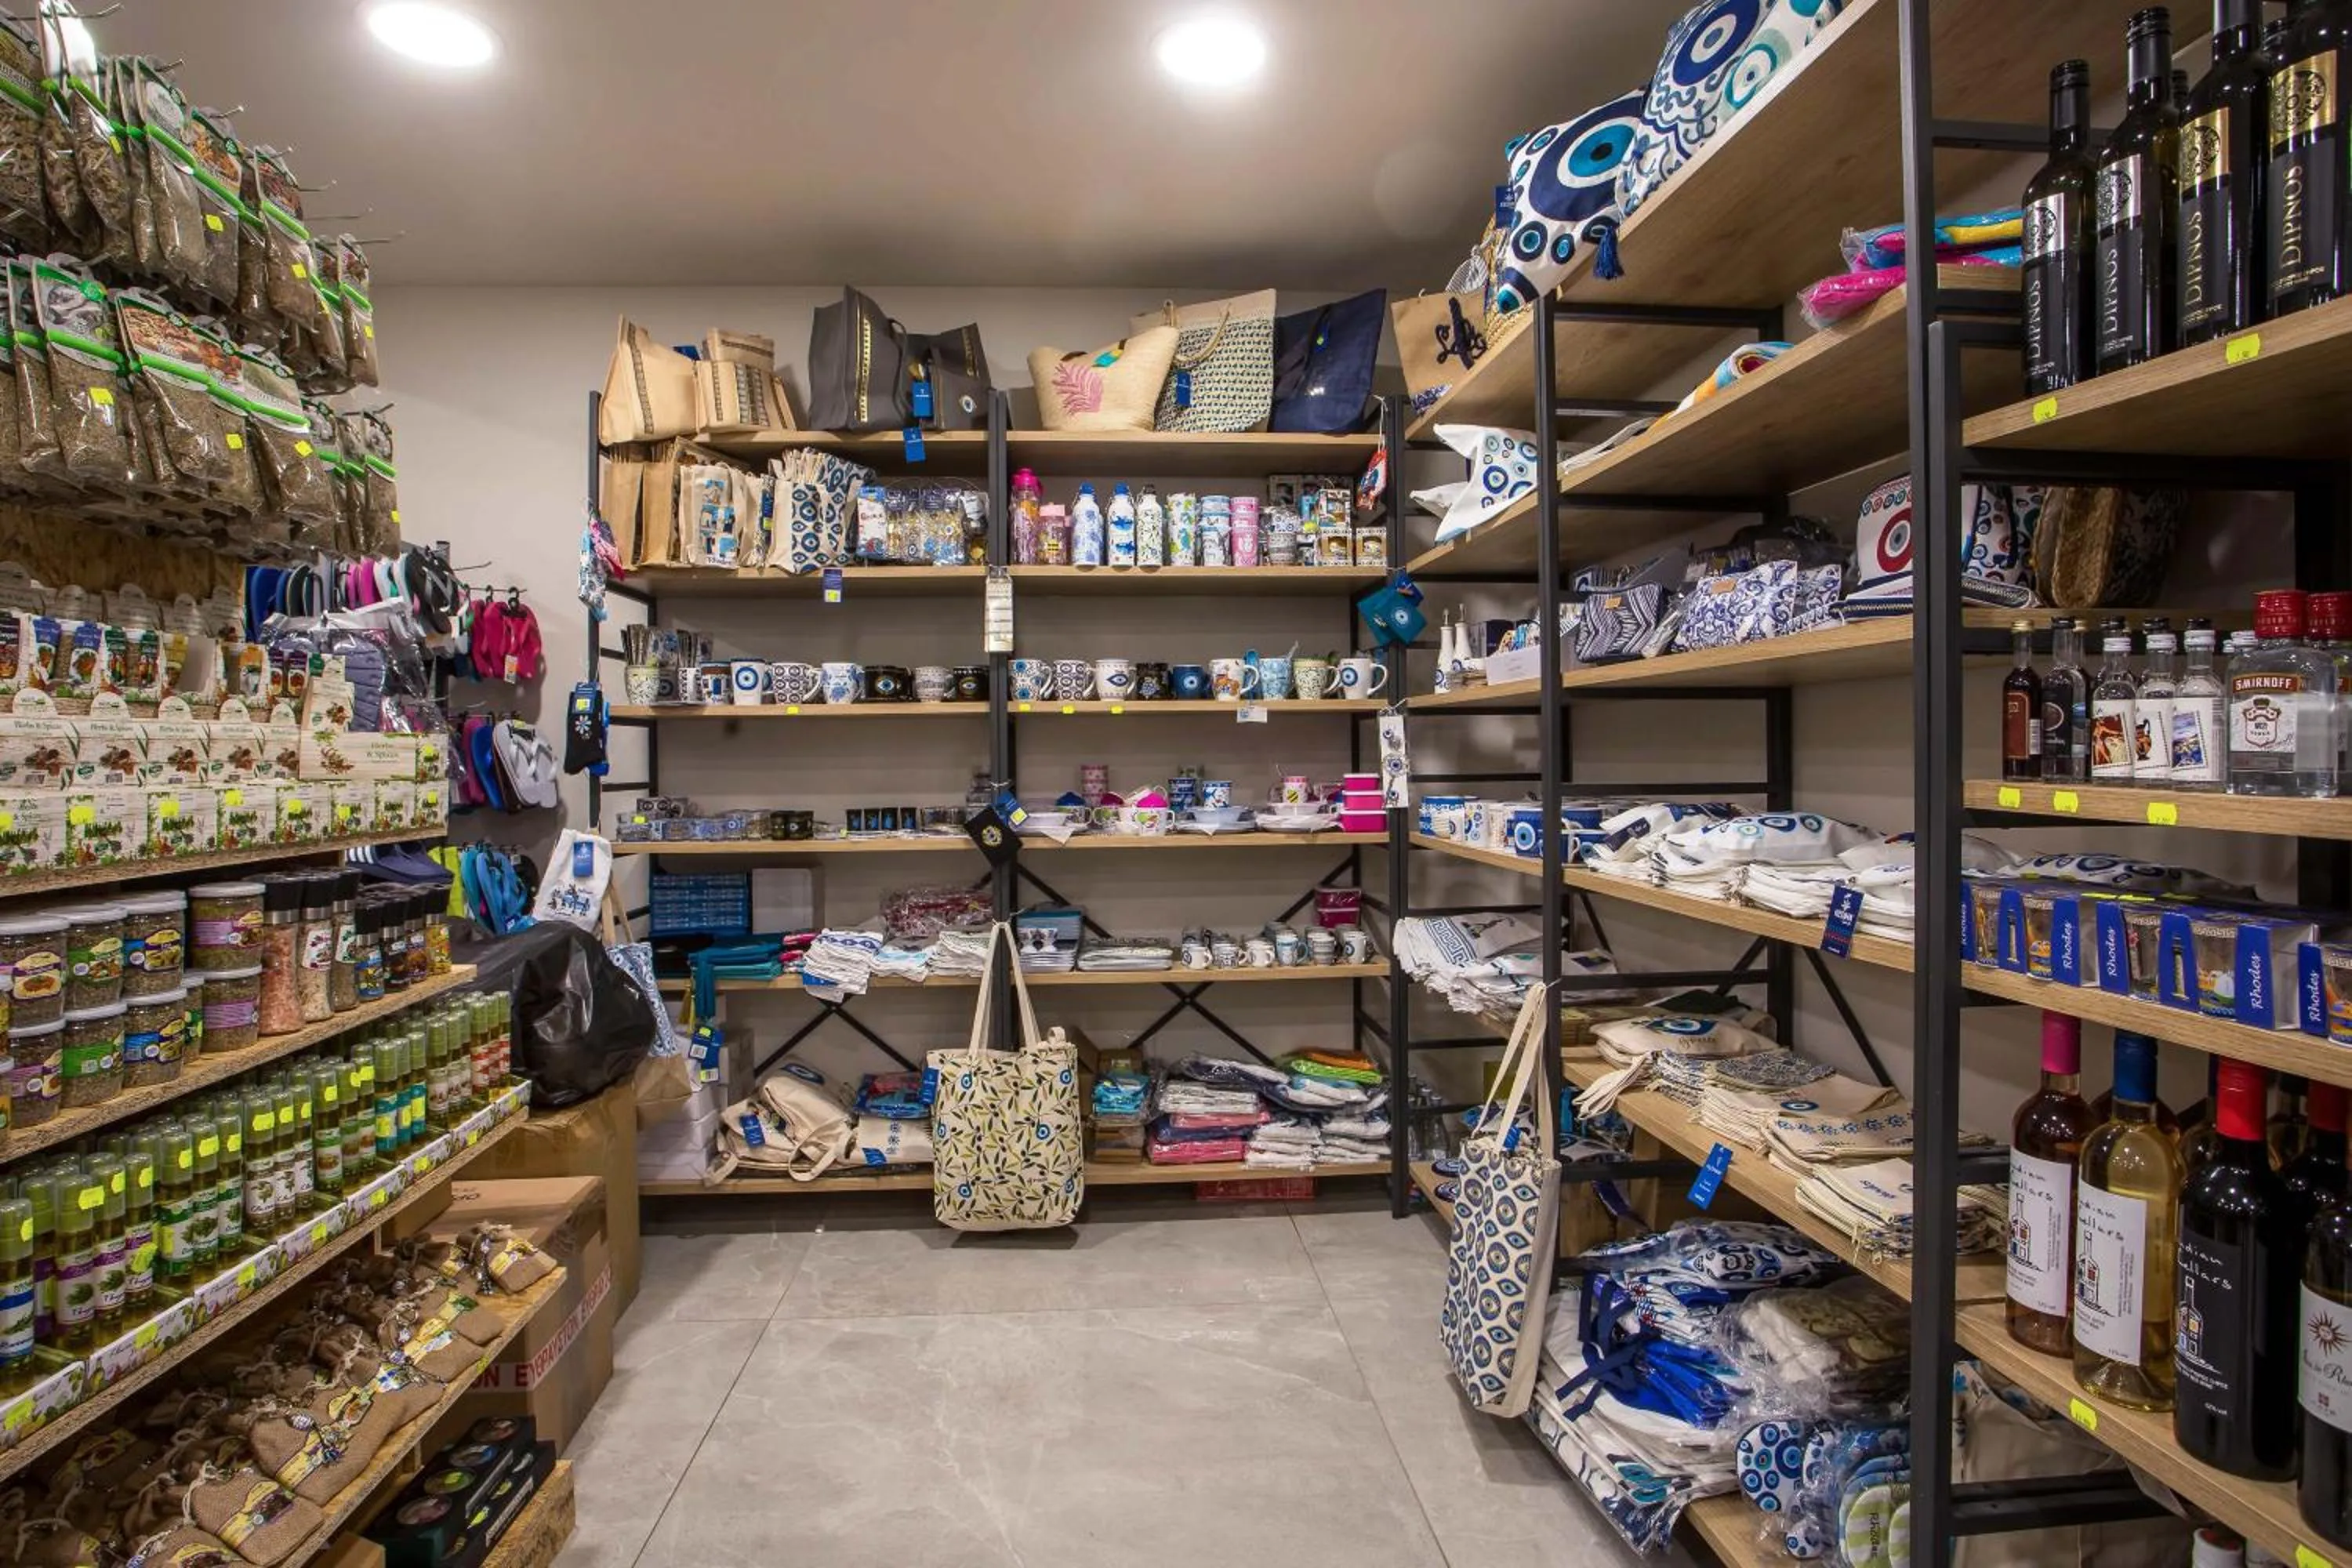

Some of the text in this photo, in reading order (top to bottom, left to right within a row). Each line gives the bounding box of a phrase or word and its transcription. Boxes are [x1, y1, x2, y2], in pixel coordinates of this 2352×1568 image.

[2281, 165, 2303, 268] DIPNOS
[2184, 210, 2202, 305] DIPNOS
[2028, 279, 2041, 359] DIPNOS
[2102, 249, 2118, 336] DIPNOS
[2235, 677, 2292, 691] SMIRNOFF
[2061, 920, 2074, 970] Rhodes
[2105, 925, 2117, 977] Rhodes
[2249, 951, 2263, 1010] Rhodes
[2308, 969, 2321, 1022] Rhodes
